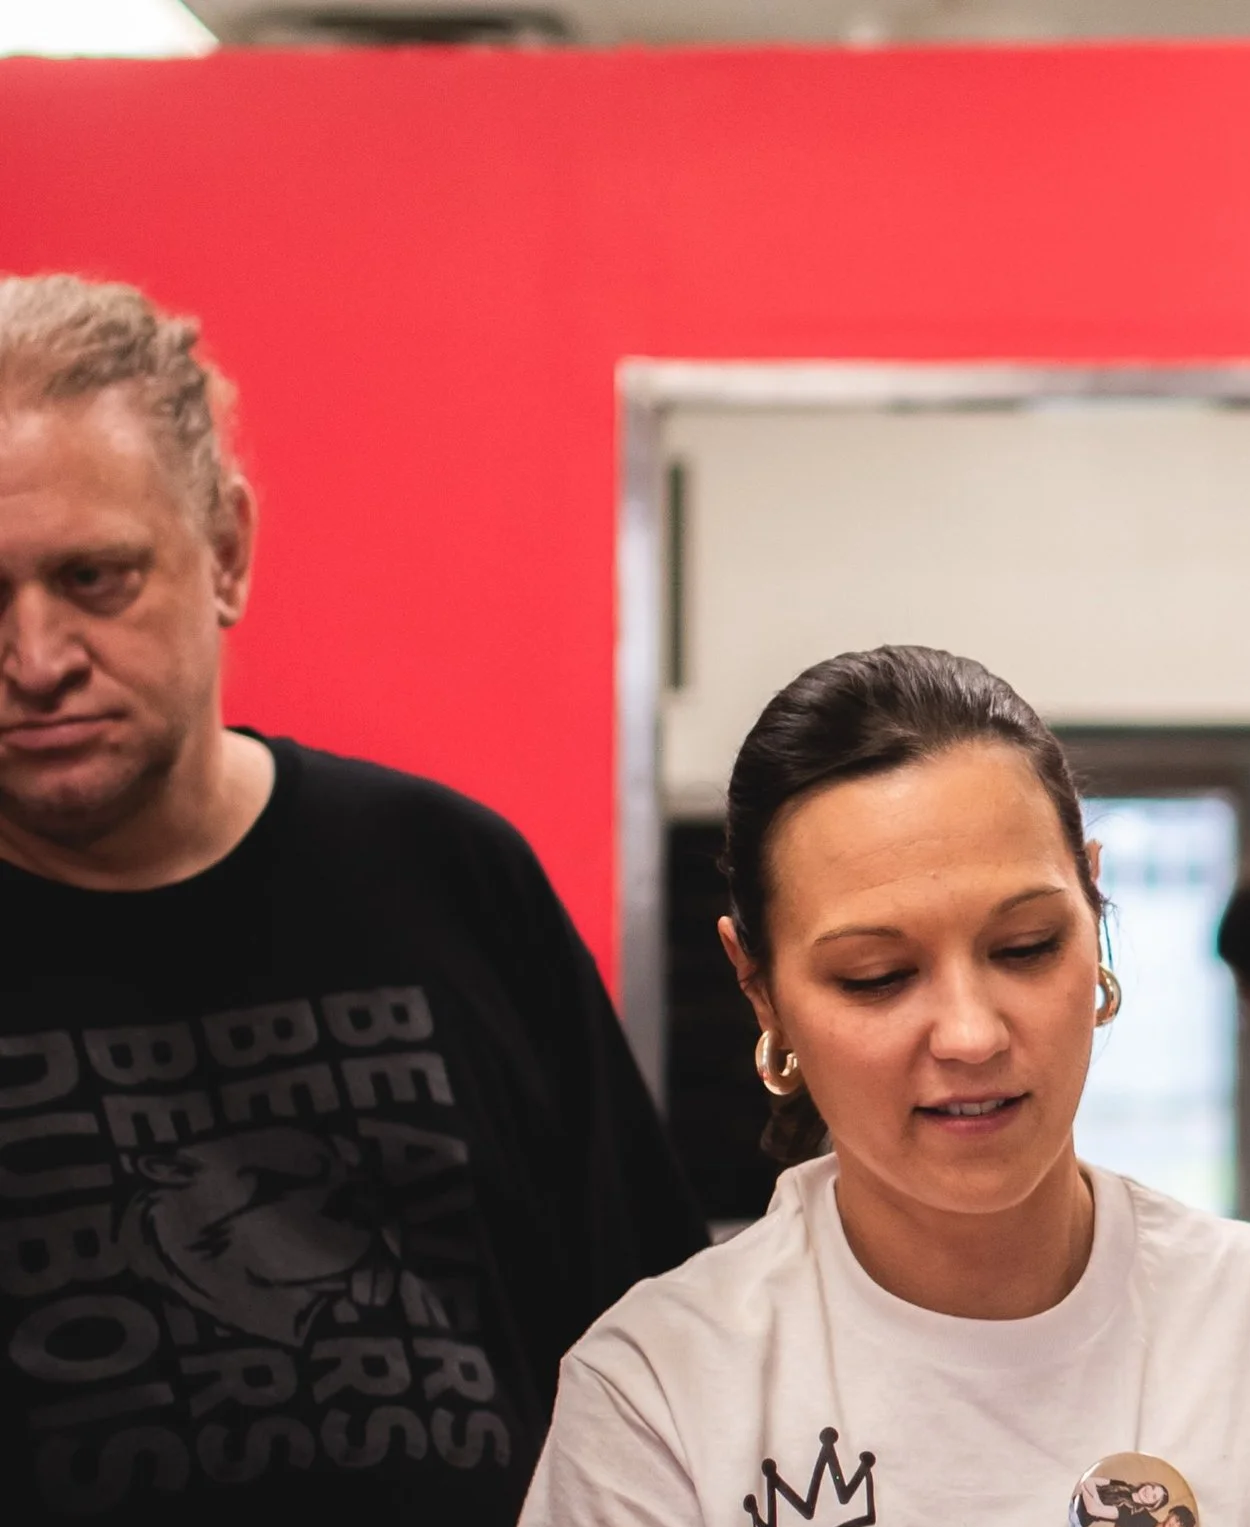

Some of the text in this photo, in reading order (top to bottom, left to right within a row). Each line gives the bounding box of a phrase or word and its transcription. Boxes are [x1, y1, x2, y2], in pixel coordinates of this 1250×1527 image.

[82, 1021, 315, 1483] BERS
[200, 998, 428, 1469] BERS
[321, 986, 510, 1468] BEAVERS
